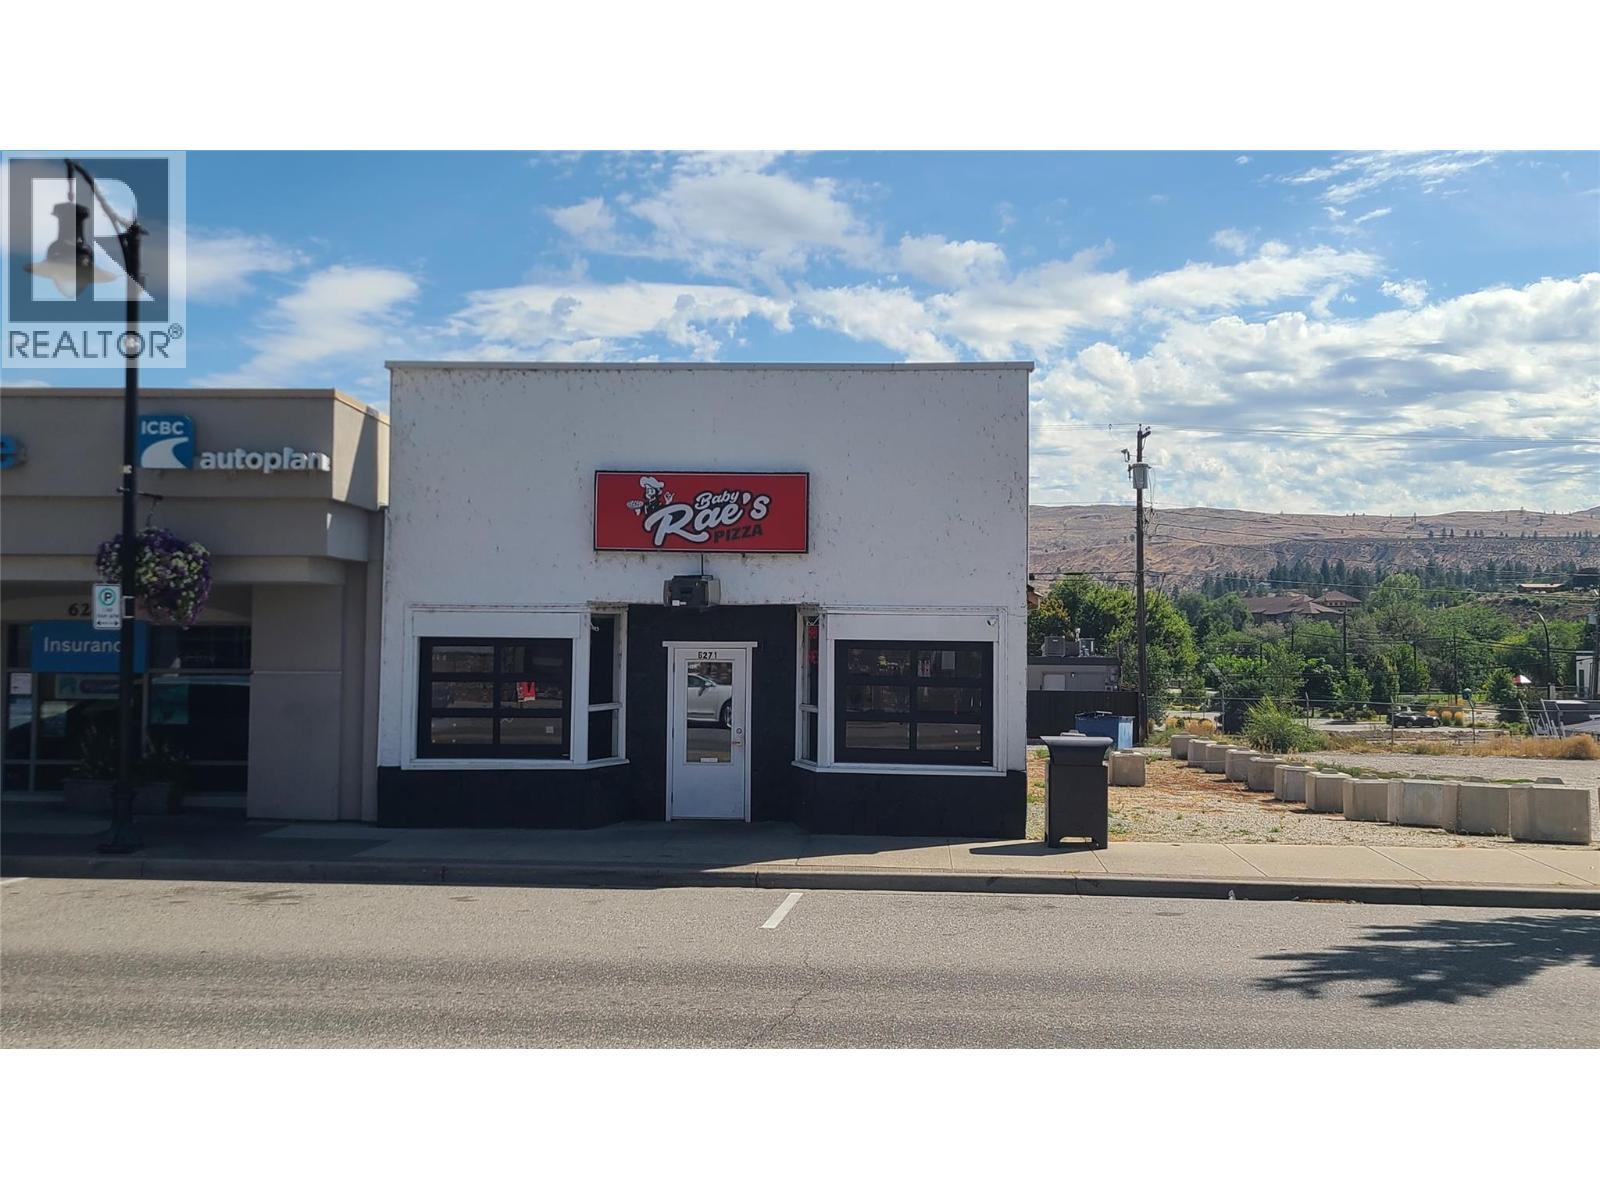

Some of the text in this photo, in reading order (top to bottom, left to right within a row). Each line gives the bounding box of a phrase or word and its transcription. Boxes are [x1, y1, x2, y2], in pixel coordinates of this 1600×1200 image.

[141, 420, 184, 434] ICBC
[200, 447, 330, 473] autoplan
[694, 490, 740, 509] Baby
[644, 492, 770, 546] Rae's
[712, 523, 763, 543] PIZZA
[68, 603, 90, 616] 62
[44, 637, 120, 653] Insuranc
